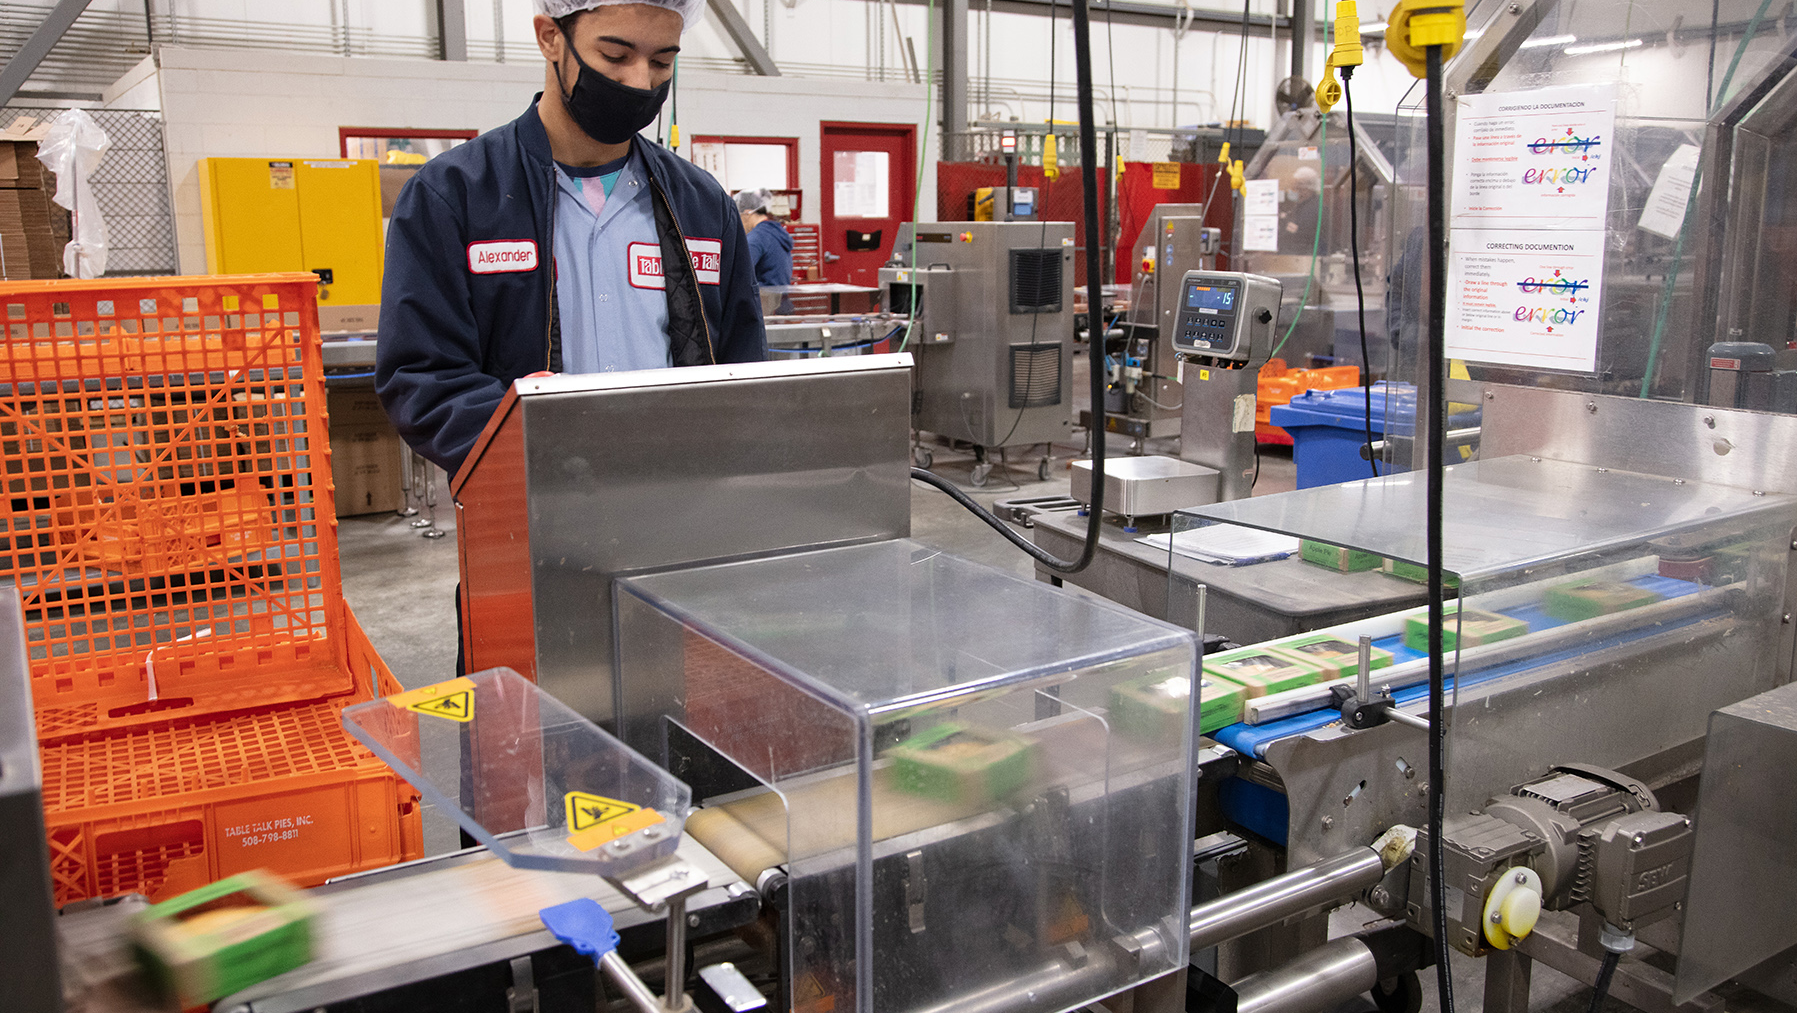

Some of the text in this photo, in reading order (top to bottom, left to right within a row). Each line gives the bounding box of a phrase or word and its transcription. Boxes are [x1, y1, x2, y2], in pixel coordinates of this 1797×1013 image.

[1523, 167, 1596, 184] error
[478, 249, 533, 264] Alexander
[1514, 306, 1585, 324] error
[225, 815, 314, 837] TABLE TALK PIES, INC.
[242, 829, 298, 847] 508-798-8811
